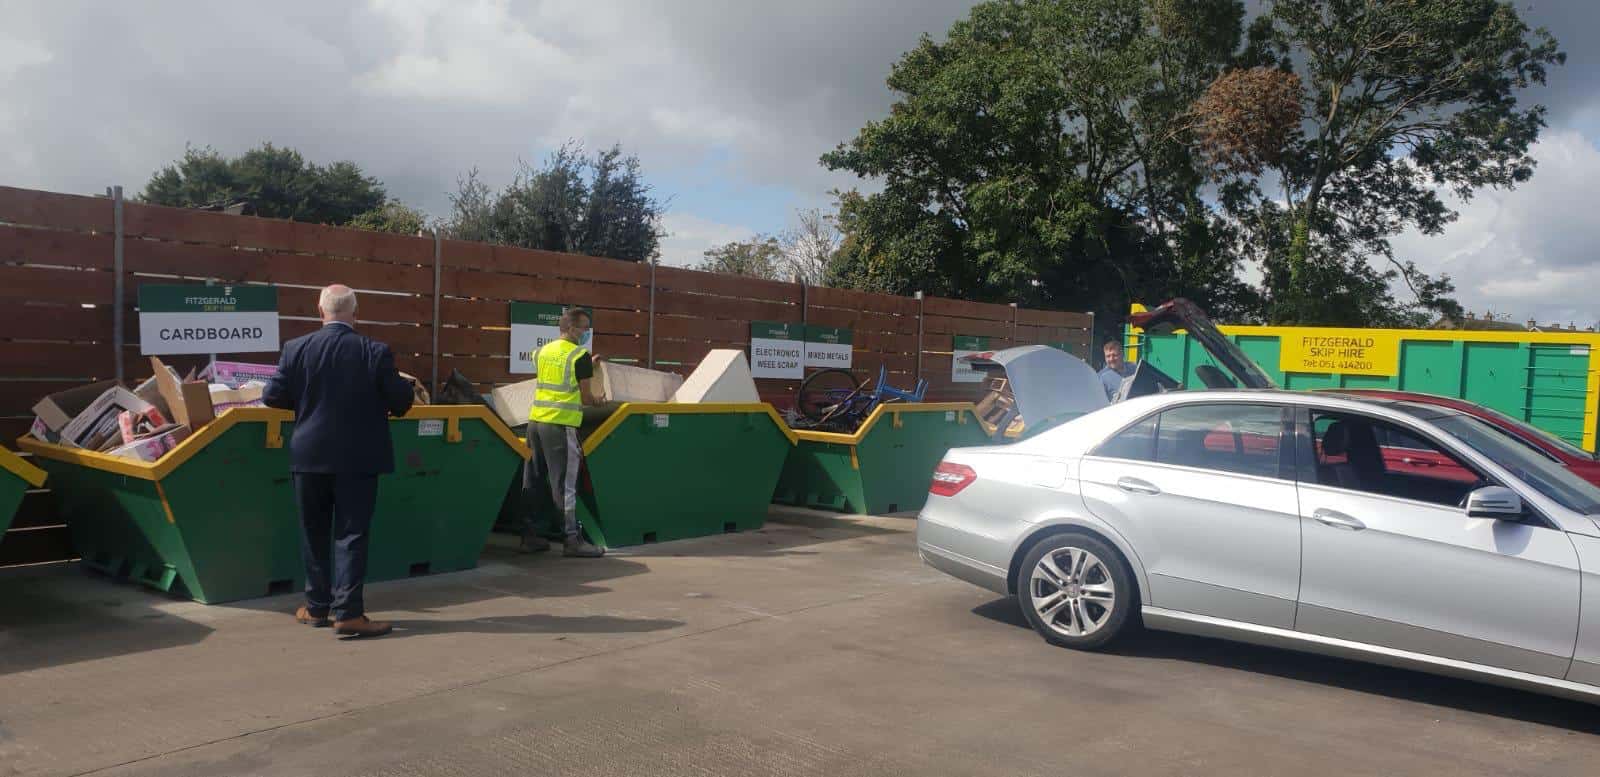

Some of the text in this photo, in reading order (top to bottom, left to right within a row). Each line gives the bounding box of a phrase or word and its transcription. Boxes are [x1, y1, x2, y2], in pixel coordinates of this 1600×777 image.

[160, 327, 262, 340] CARDBOARD
[1303, 336, 1374, 348] FITZGERALD
[755, 347, 800, 358] ELECTRONICS
[807, 351, 849, 361] MIXED METALS
[1310, 347, 1365, 359] SKIP HIRE
[757, 360, 798, 368] WEEE SCRAP
[1319, 360, 1336, 369] 051
[1339, 360, 1373, 370] 414200
